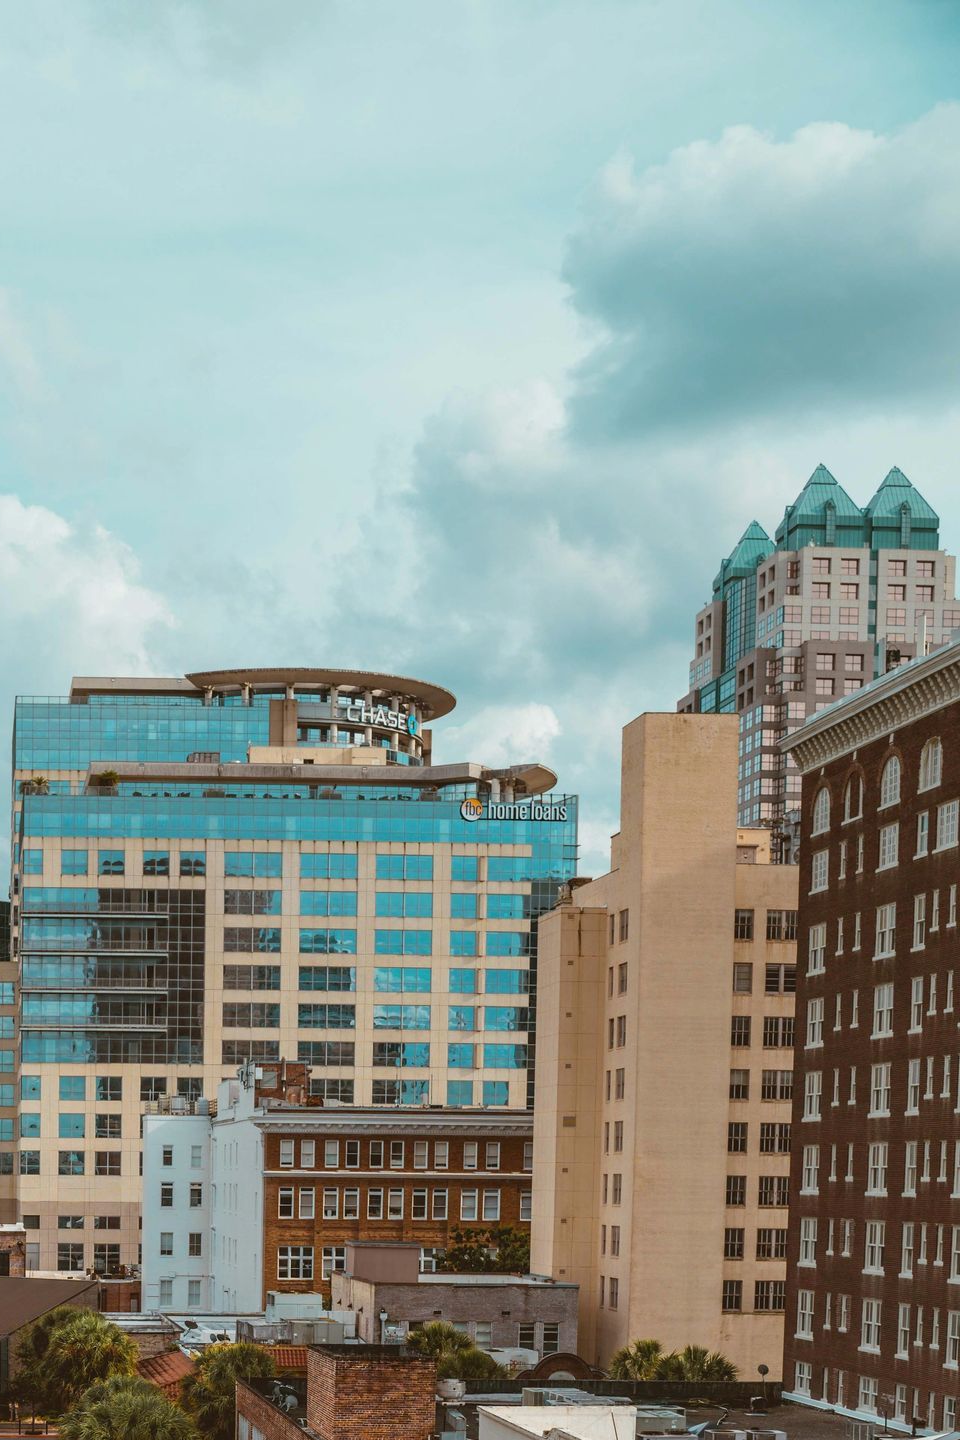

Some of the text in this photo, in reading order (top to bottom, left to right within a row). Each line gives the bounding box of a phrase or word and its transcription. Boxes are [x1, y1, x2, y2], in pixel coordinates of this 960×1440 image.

[347, 705, 406, 730] CHASE
[465, 800, 568, 821] fbc home loans
